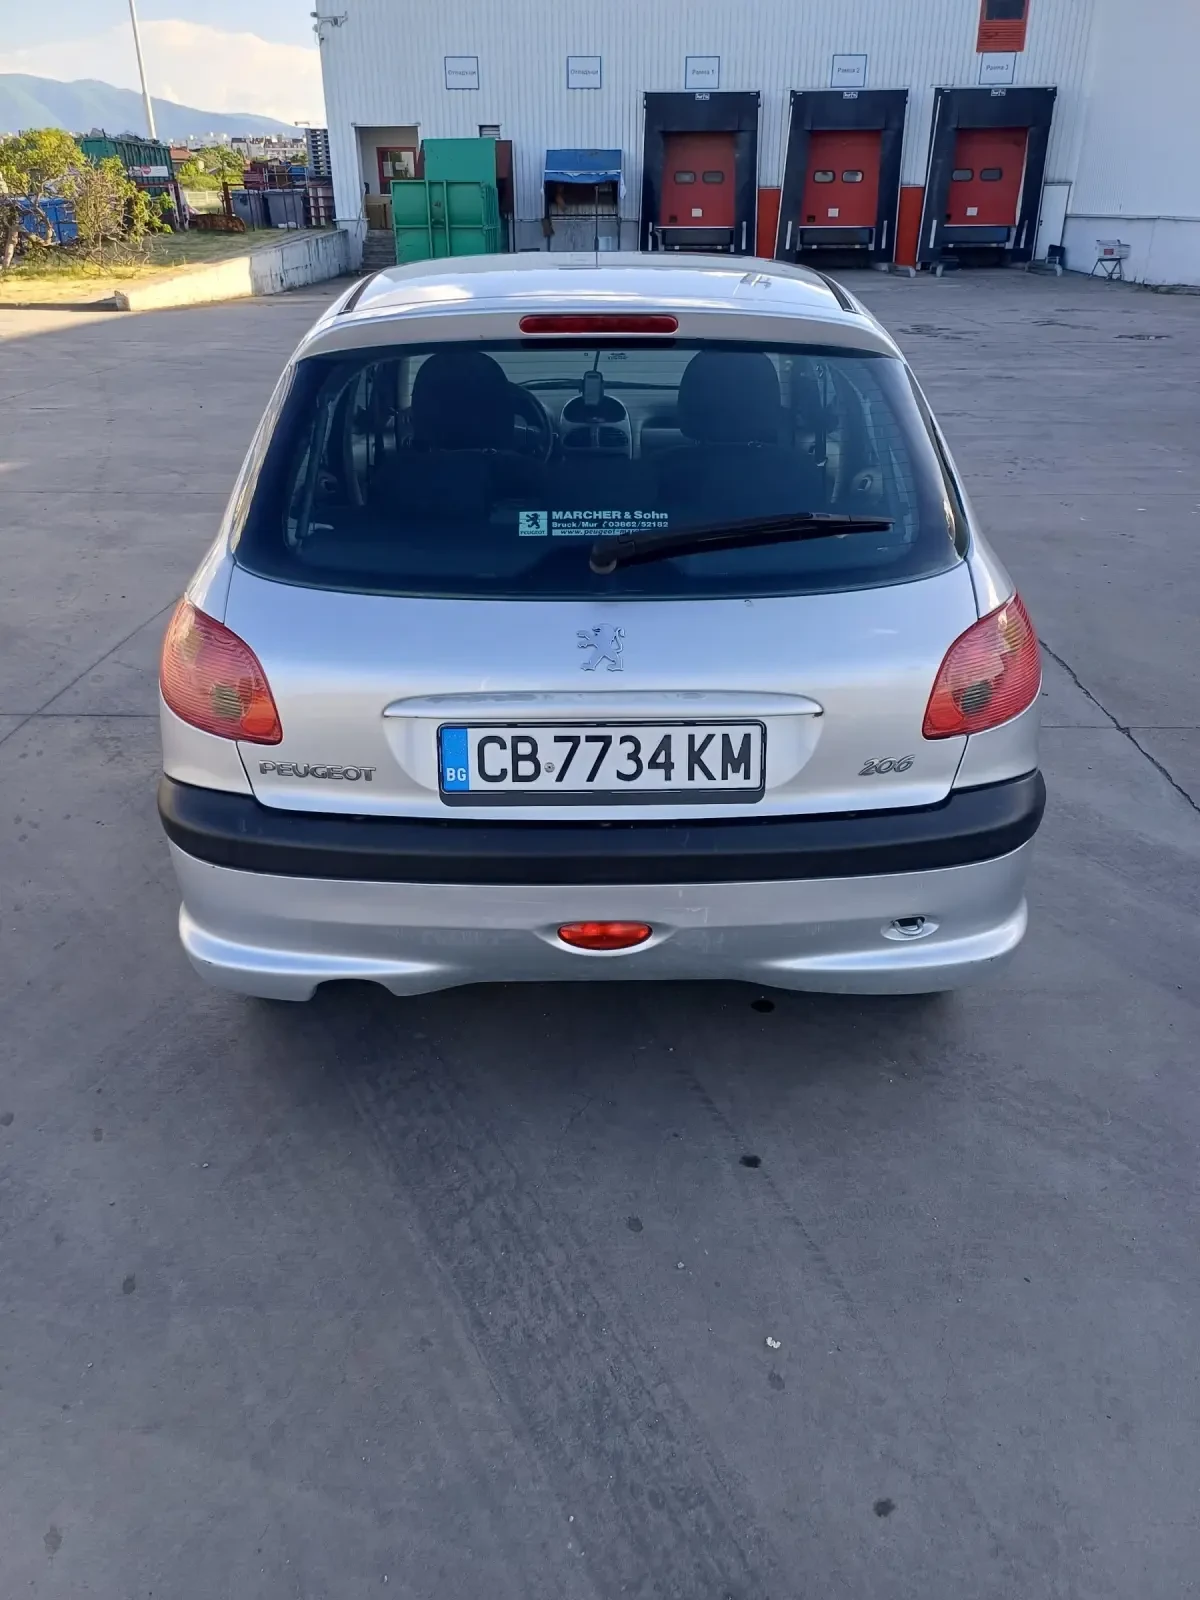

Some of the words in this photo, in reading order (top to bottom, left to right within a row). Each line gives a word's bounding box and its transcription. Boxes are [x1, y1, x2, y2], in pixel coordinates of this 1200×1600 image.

[552, 511, 621, 519] MARCHER
[624, 511, 631, 519] &
[633, 511, 668, 519] Sohn
[477, 735, 541, 782] CB
[553, 734, 674, 782] 7734
[687, 733, 751, 781] KM
[858, 754, 915, 776] 206
[258, 760, 377, 781] PEUGEOT
[446, 767, 466, 782] BG
